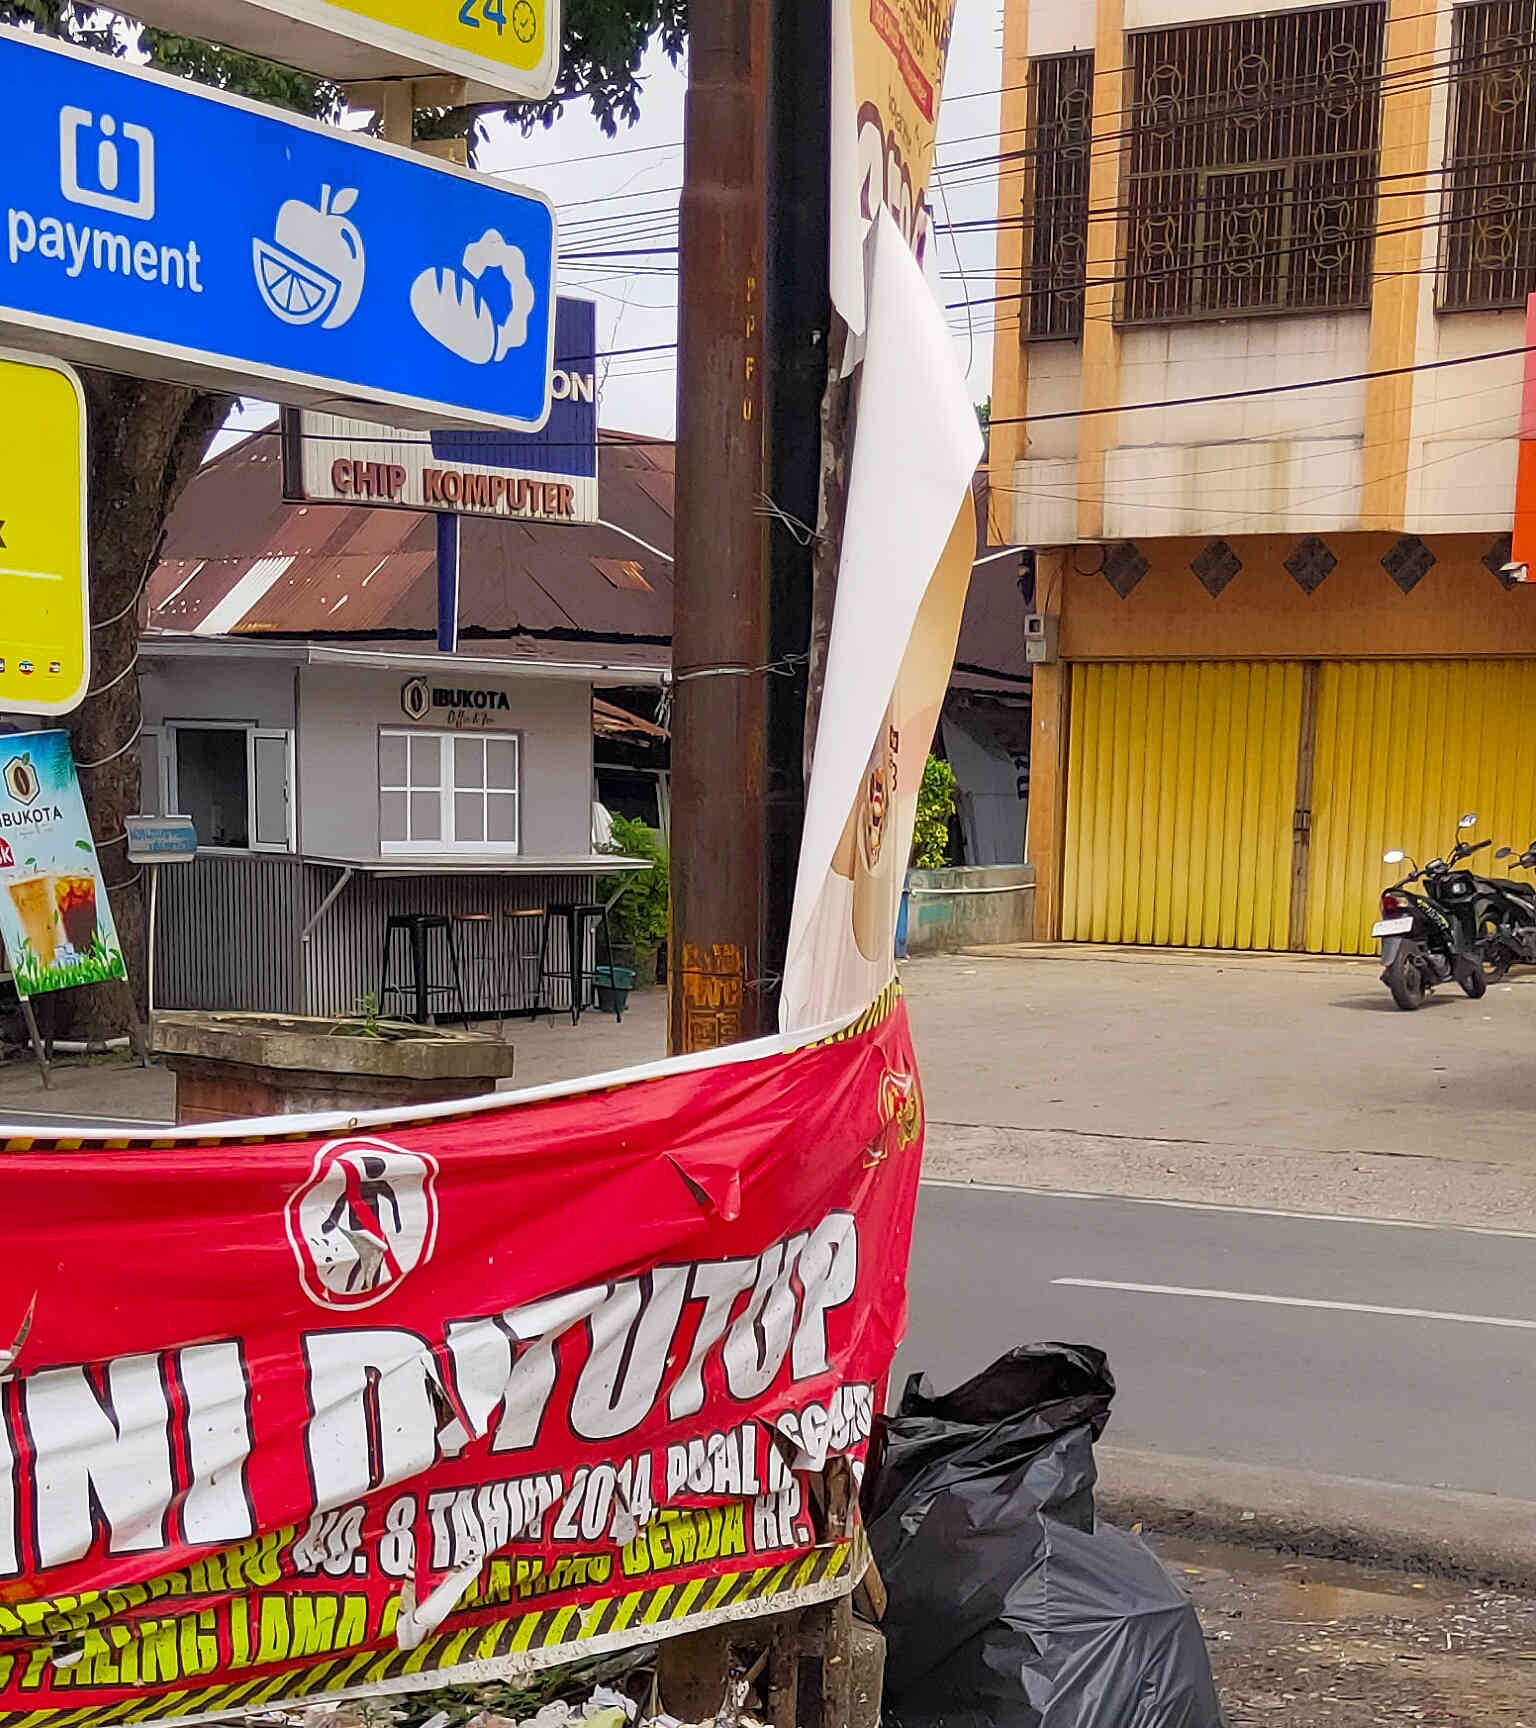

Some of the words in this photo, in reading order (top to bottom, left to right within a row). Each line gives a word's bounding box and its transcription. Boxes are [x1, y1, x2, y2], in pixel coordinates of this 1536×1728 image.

[8, 208, 204, 293] payment
[331, 457, 407, 499] CHIP
[422, 467, 575, 516] KOMPUTER
[432, 687, 511, 711] IBUKOTA
[379, 1496, 416, 1577] 8
[228, 1594, 367, 1670] LAMA
